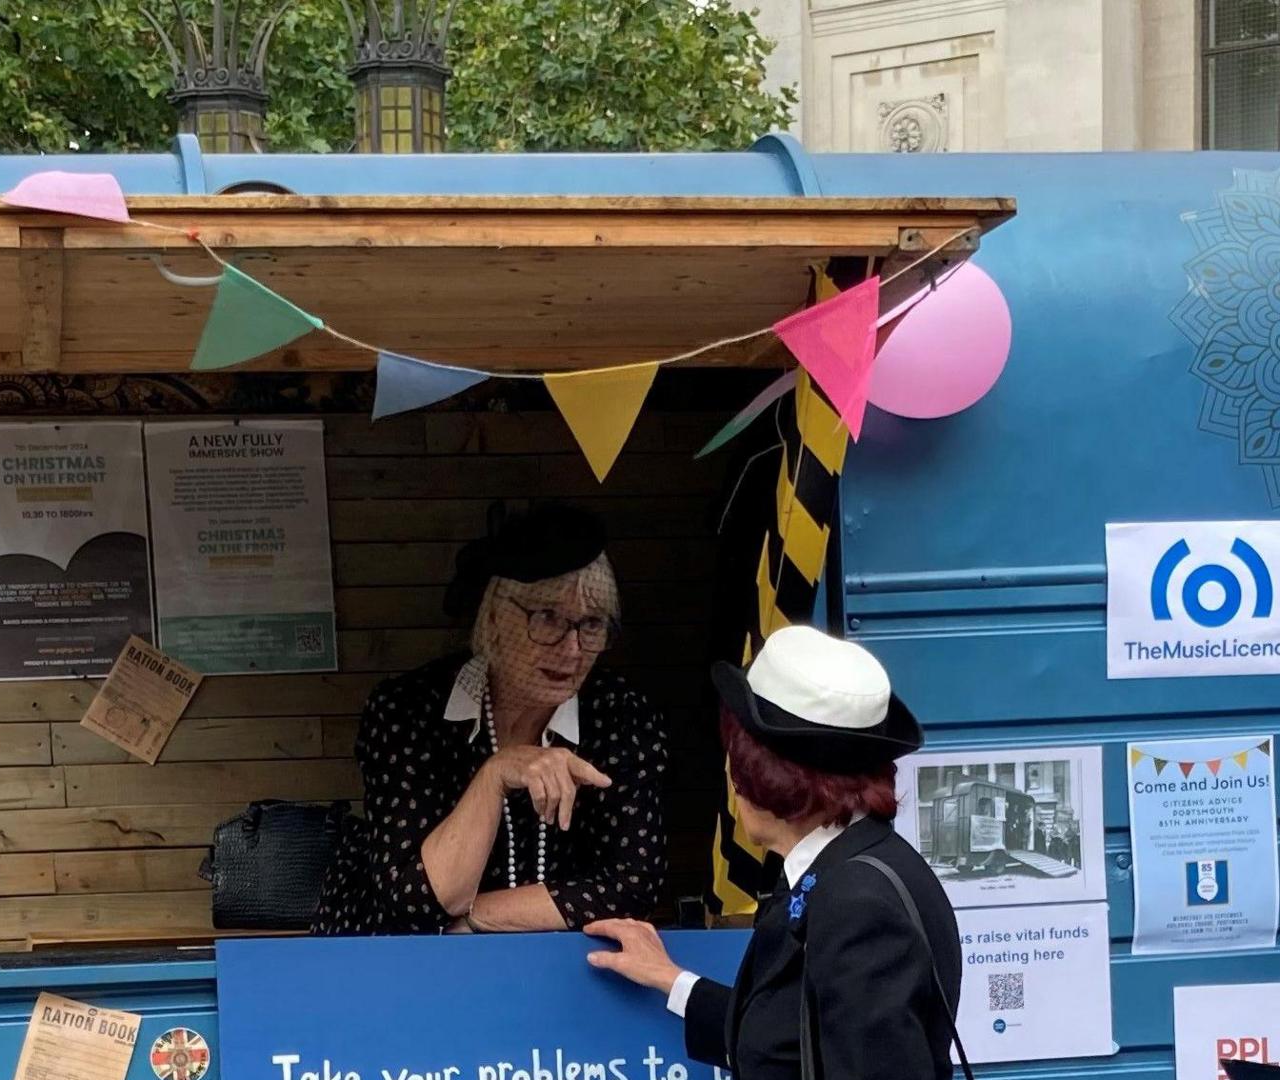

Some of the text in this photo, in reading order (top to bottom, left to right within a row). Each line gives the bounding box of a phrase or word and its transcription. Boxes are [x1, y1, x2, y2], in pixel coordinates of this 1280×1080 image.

[189, 433, 284, 448] A NEW FULLY
[189, 447, 284, 459] IMMERSIVE SHOW
[2, 456, 106, 471] CHRISTMAS
[3, 471, 106, 485] ON THE FRONT
[46, 510, 57, 518] TO
[198, 528, 285, 541] CHRISTMAS
[198, 542, 286, 554] ON THE FRONT
[127, 646, 196, 694] RATION BOOK
[1134, 774, 1271, 794] Come and Join Us!
[1163, 797, 1243, 808] CITIZENS ADVICE
[1173, 807, 1234, 816] PORTSMOUTH
[1185, 816, 1249, 826] ANNIVERSARY
[977, 930, 1011, 943] raise
[1016, 928, 1045, 941] vital
[1050, 925, 1089, 940] funds
[967, 949, 1065, 965] donating here
[42, 1006, 96, 1032] RATION
[98, 1019, 138, 1043] BOOK
[1217, 1036, 1280, 1070] PPL
